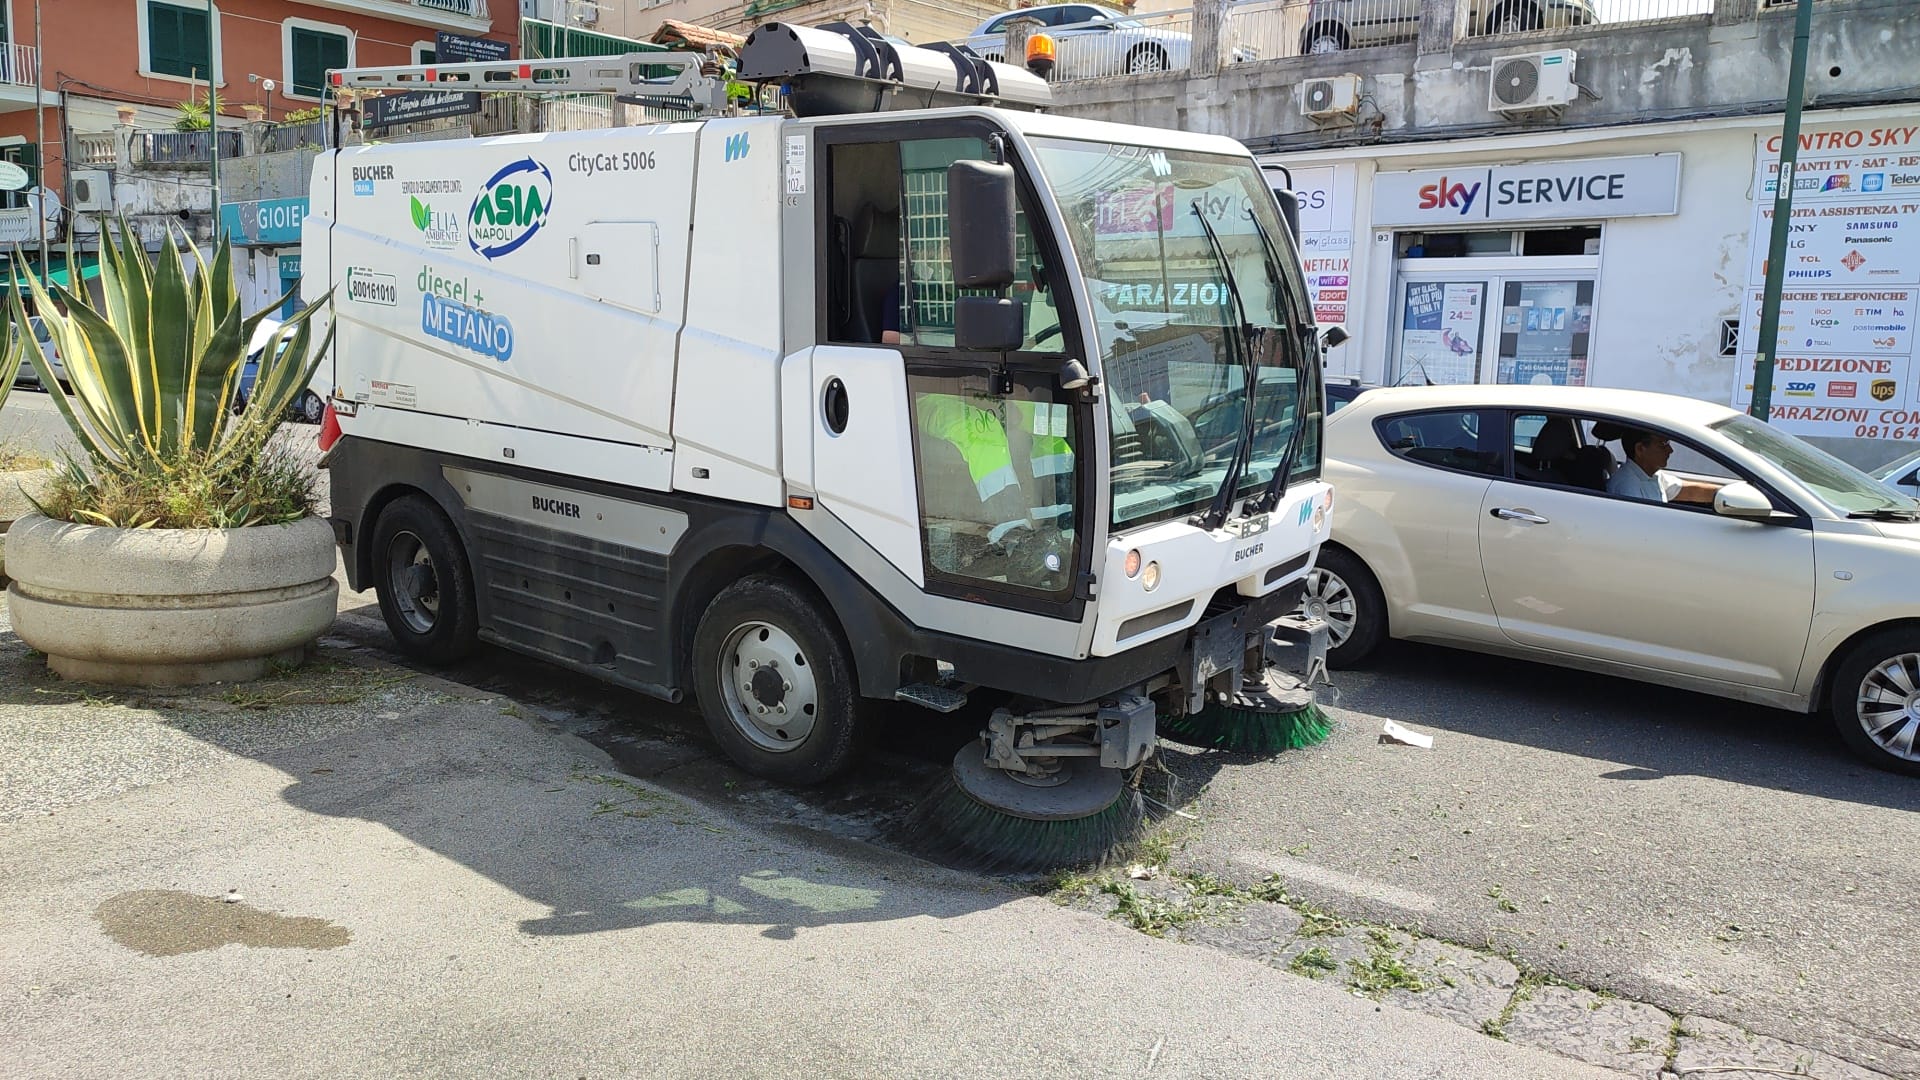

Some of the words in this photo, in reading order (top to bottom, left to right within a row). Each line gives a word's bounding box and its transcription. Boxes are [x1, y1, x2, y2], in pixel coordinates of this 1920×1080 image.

[1766, 131, 1864, 153] CNTRO
[1868, 127, 1920, 148] SKY
[569, 153, 618, 176] CityCat
[623, 151, 656, 174] 5006
[1833, 159, 1853, 170] TV
[1861, 157, 1888, 169] SAT
[352, 165, 395, 181] BUCHER
[1418, 176, 1481, 215] sky
[1497, 174, 1626, 205] SERVICE
[474, 184, 544, 226] ASIA
[1818, 205, 1899, 219] ASSISTENZA
[1901, 204, 1919, 215] TV
[1846, 220, 1899, 231] SAMSUNG
[475, 227, 513, 241] NAPOLI
[1844, 236, 1893, 244] Panasonic
[1790, 240, 1806, 249] LG
[1303, 259, 1350, 273] NETFLIX
[1788, 270, 1832, 278] PHILIPS
[417, 265, 468, 303] diesel
[353, 280, 395, 303] 800161010
[1320, 291, 1347, 302] sport
[1820, 292, 1909, 301] TELEFONICHE
[1408, 293, 1431, 307] MOLTO
[1433, 301, 1441, 313] TV
[1448, 310, 1463, 321] 24
[1865, 308, 1883, 316] TIM
[425, 300, 510, 354] METANO
[1810, 317, 1833, 327] Lyca
[1852, 324, 1907, 332] postemobile
[1785, 382, 1816, 391] SDA
[1872, 385, 1895, 399] ups
[532, 495, 581, 519] BUCHER
[1234, 543, 1265, 562] BUCHER
